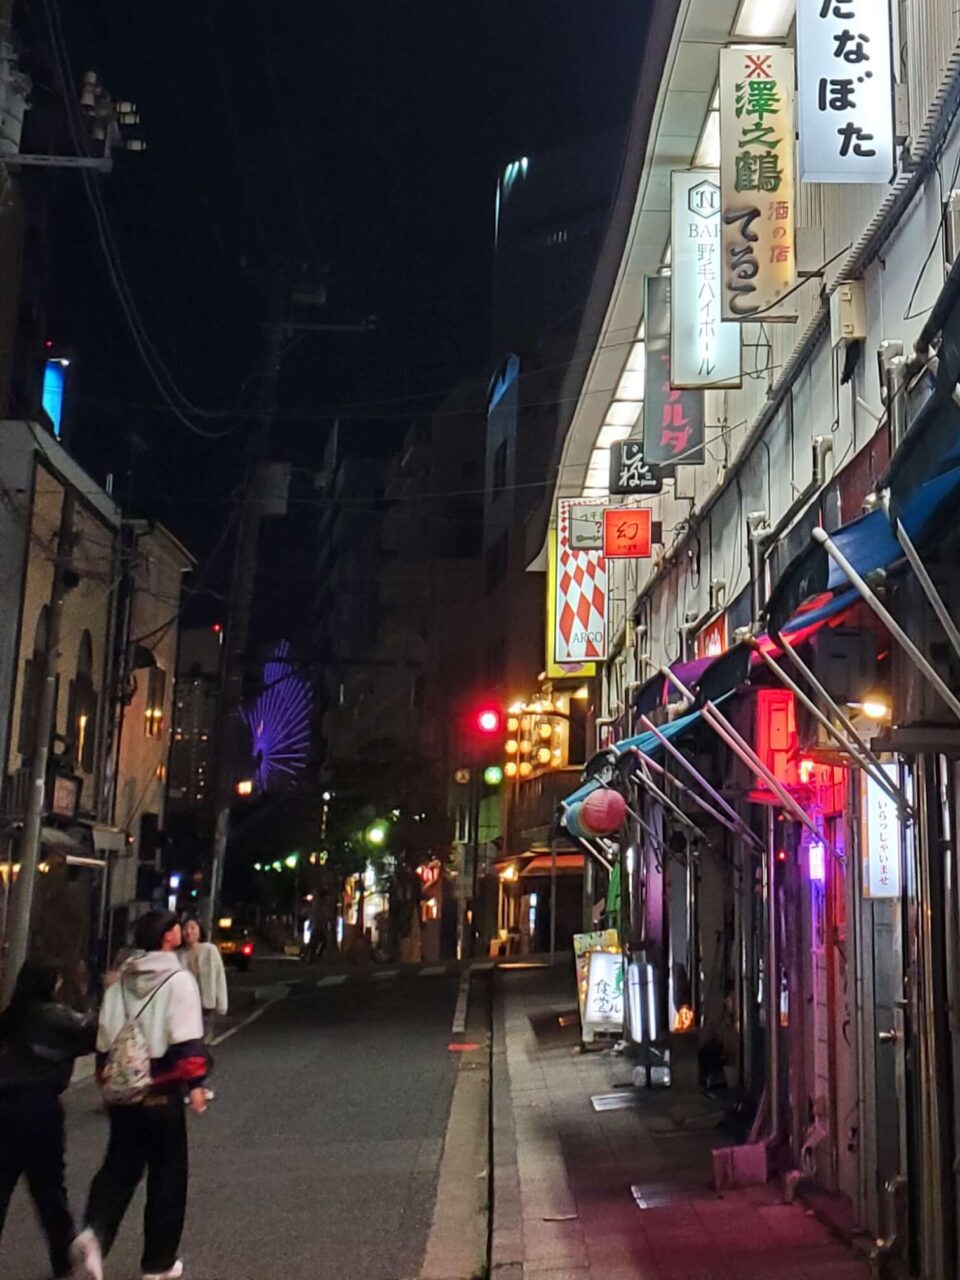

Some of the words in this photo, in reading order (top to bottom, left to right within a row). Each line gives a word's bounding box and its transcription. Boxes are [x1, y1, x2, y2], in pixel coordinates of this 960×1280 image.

[723, 206, 762, 315] てるこ
[767, 200, 791, 264] 酒の店
[697, 243, 716, 376] 野毛ハイボール
[616, 521, 639, 540] 幻
[878, 800, 889, 886] いらっしゃいませ
